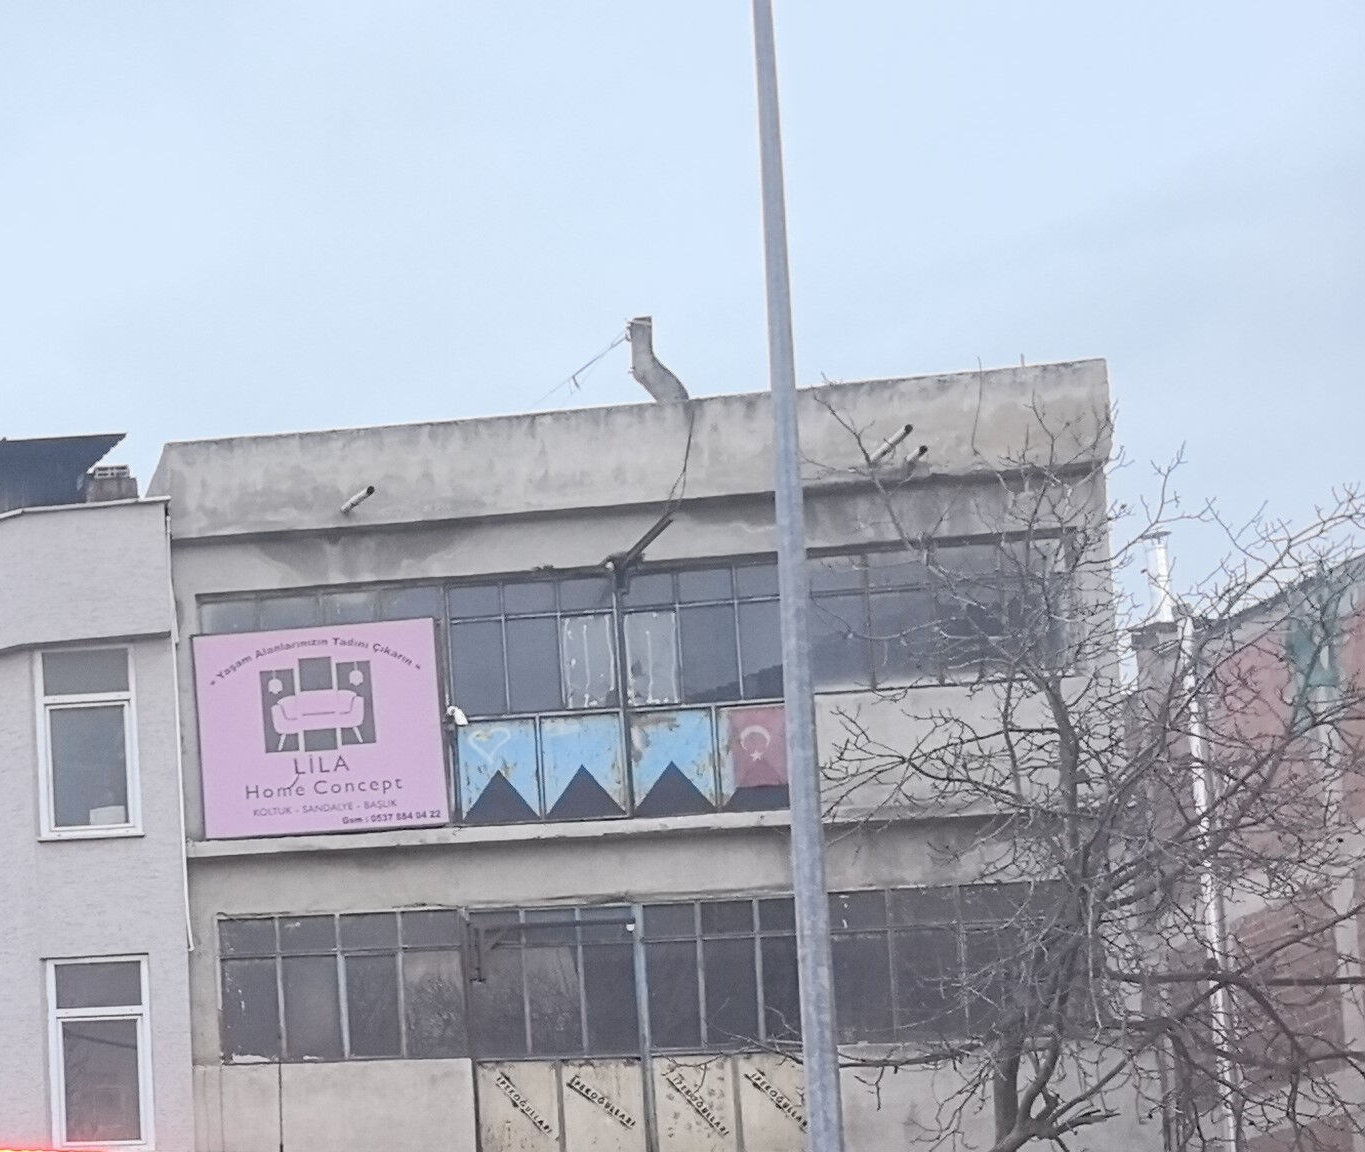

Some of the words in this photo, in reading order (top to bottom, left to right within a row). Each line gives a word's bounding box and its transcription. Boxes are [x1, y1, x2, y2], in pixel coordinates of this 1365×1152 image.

[293, 755, 349, 774] LİLA
[245, 784, 305, 799] Home
[313, 778, 403, 795] Concept
[430, 809, 441, 818] 22
